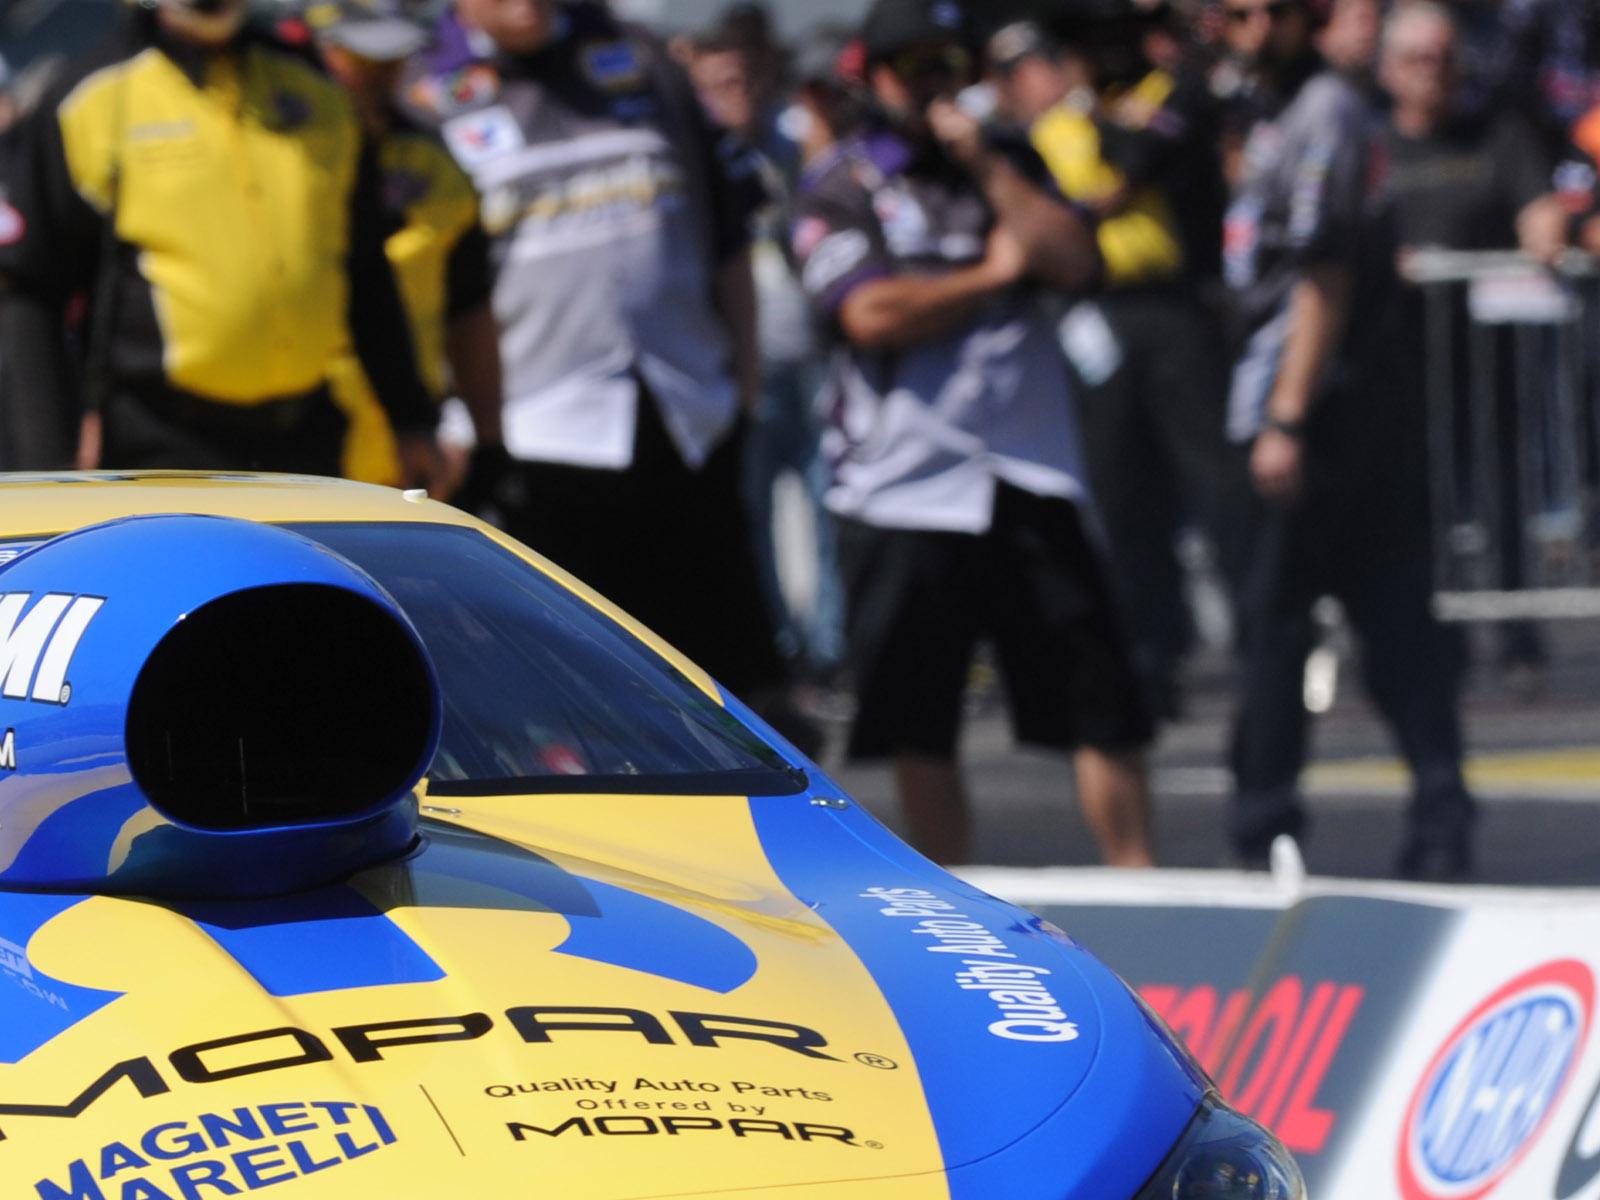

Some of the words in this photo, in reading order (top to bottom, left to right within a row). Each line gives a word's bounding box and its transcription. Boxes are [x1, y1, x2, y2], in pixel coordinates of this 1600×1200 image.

[858, 886, 969, 919] Parts
[911, 919, 1018, 959] Auto
[955, 959, 1080, 1043] Quality
[483, 1077, 617, 1098] Quality
[633, 1077, 721, 1094] Auto
[732, 1080, 834, 1102] Parts
[575, 1099, 710, 1112] Offered
[729, 1100, 767, 1117] by
[34, 1100, 398, 1190] MAGNETI
[505, 1116, 864, 1148] MOPAR
